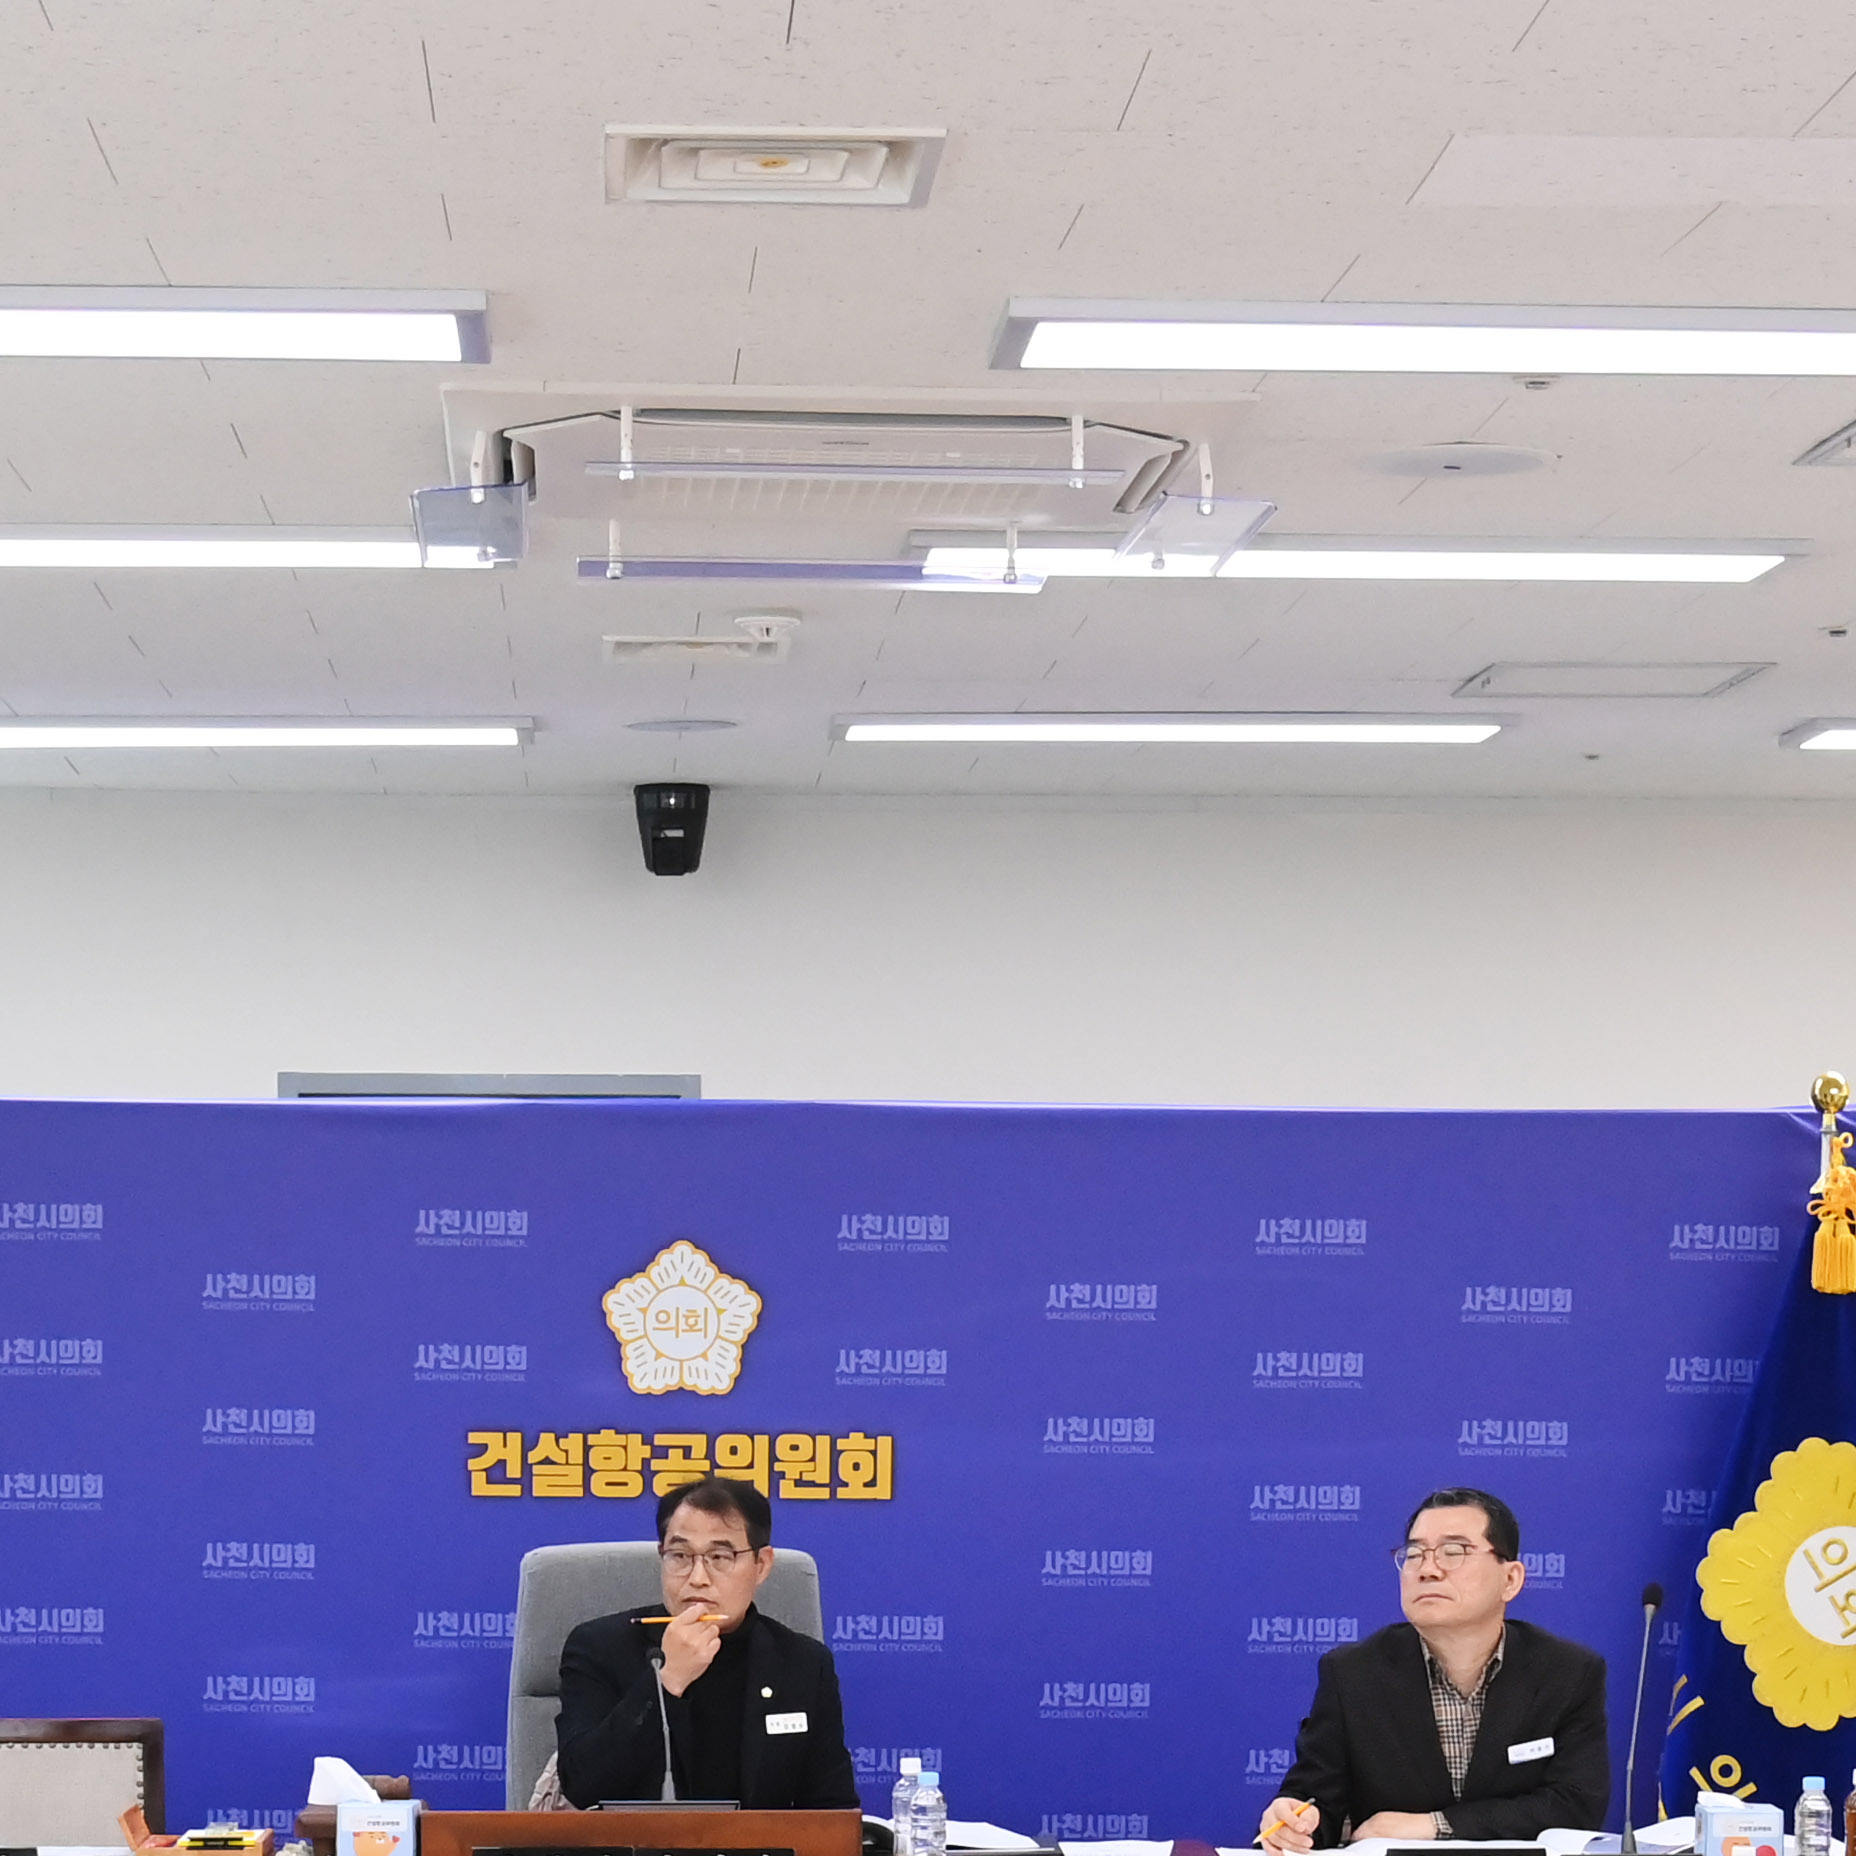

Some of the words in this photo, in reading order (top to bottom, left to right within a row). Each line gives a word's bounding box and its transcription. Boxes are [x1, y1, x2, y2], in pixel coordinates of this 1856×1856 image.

[415, 1209, 528, 1235] 사천시의회
[837, 1213, 949, 1239] 사천시의회
[1255, 1217, 1367, 1243] 사천시의회
[1669, 1223, 1779, 1249] 사천시의회
[202, 1273, 315, 1299] 사천시의회
[1045, 1282, 1157, 1308] 사천시의회
[1461, 1285, 1572, 1311] 사천시의회
[652, 1307, 708, 1339] 의회
[413, 1343, 527, 1369] 사천시의회
[835, 1348, 947, 1374] 사천시의회
[1252, 1351, 1363, 1377] 사천시의회
[1665, 1356, 1754, 1383] 사천시의
[202, 1407, 315, 1433] 사천시의회
[1043, 1416, 1154, 1442] 사천시의회
[1457, 1418, 1568, 1444] 사천시의회
[1250, 1484, 1360, 1510] 사천시의회
[202, 1542, 315, 1568] 사천시의회
[1041, 1549, 1152, 1575] 사천시의회
[832, 1615, 944, 1641] 사천시의회
[1248, 1616, 1358, 1642] 사천시의회
[203, 1675, 315, 1701] 사천시의회
[1040, 1681, 1150, 1707] 사천시의회
[413, 1744, 502, 1770] 사천시의
